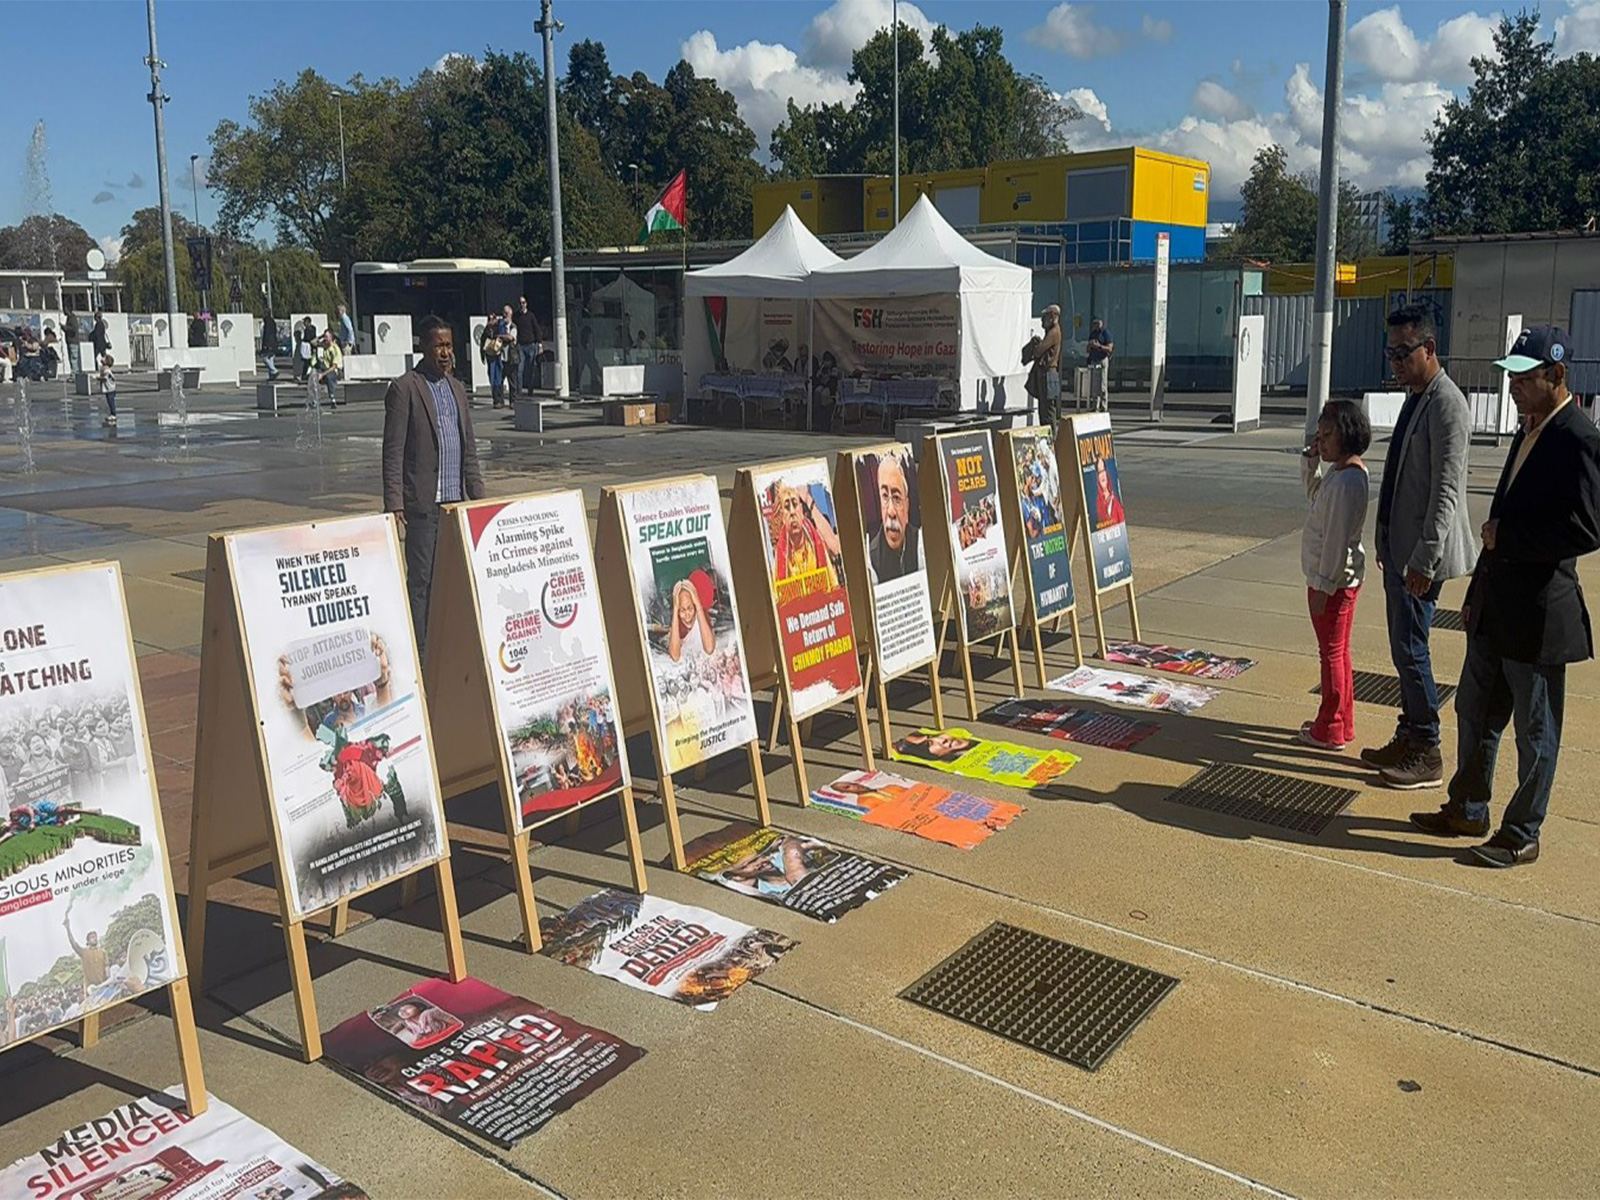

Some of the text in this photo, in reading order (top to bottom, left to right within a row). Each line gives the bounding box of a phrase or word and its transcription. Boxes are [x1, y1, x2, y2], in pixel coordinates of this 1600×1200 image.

[853, 308, 883, 328] FSH
[852, 340, 894, 358] Restoring
[898, 342, 922, 358] Hope
[925, 341, 934, 355] in
[956, 455, 982, 476] NOT
[958, 475, 986, 492] SCARS
[633, 513, 658, 524] Silence
[639, 514, 712, 544] SPEAK OUT
[494, 525, 564, 546] Alarming Spike
[488, 537, 574, 562] in Crimes against
[1031, 542, 1044, 560] THE
[486, 552, 580, 578] Bangladesh Minorities
[279, 562, 347, 594] SILENCED
[550, 572, 585, 589] CRIME
[281, 592, 322, 609] TYRANNY
[550, 583, 586, 598] AGAINST
[308, 596, 370, 628] LOUDEST
[554, 604, 573, 616] 2442
[786, 600, 845, 634] We Demand Safe
[506, 614, 541, 632] CRIME
[4, 624, 47, 652] ONE
[506, 626, 542, 642] AGAINST
[802, 620, 836, 648] Return of
[287, 646, 310, 666] STOP
[313, 633, 354, 656] ATTACKS
[509, 646, 528, 659] 1045
[300, 647, 367, 680] JOURNALISTS!
[675, 733, 700, 747] Bringing
[700, 730, 726, 750] JUSTICE
[54, 848, 136, 884] MINORITIES
[54, 885, 70, 896] are
[72, 874, 100, 892] under
[102, 867, 126, 885] siege
[608, 914, 670, 952] ACCESS TO
[620, 924, 711, 980] DENIED
[401, 1016, 506, 1078] CLASS 5 STUDENT
[406, 1014, 562, 1104] RAPED
[506, 1058, 533, 1079] SCREAM
[39, 1101, 154, 1168] MEDIA
[211, 1178, 224, 1188] for
